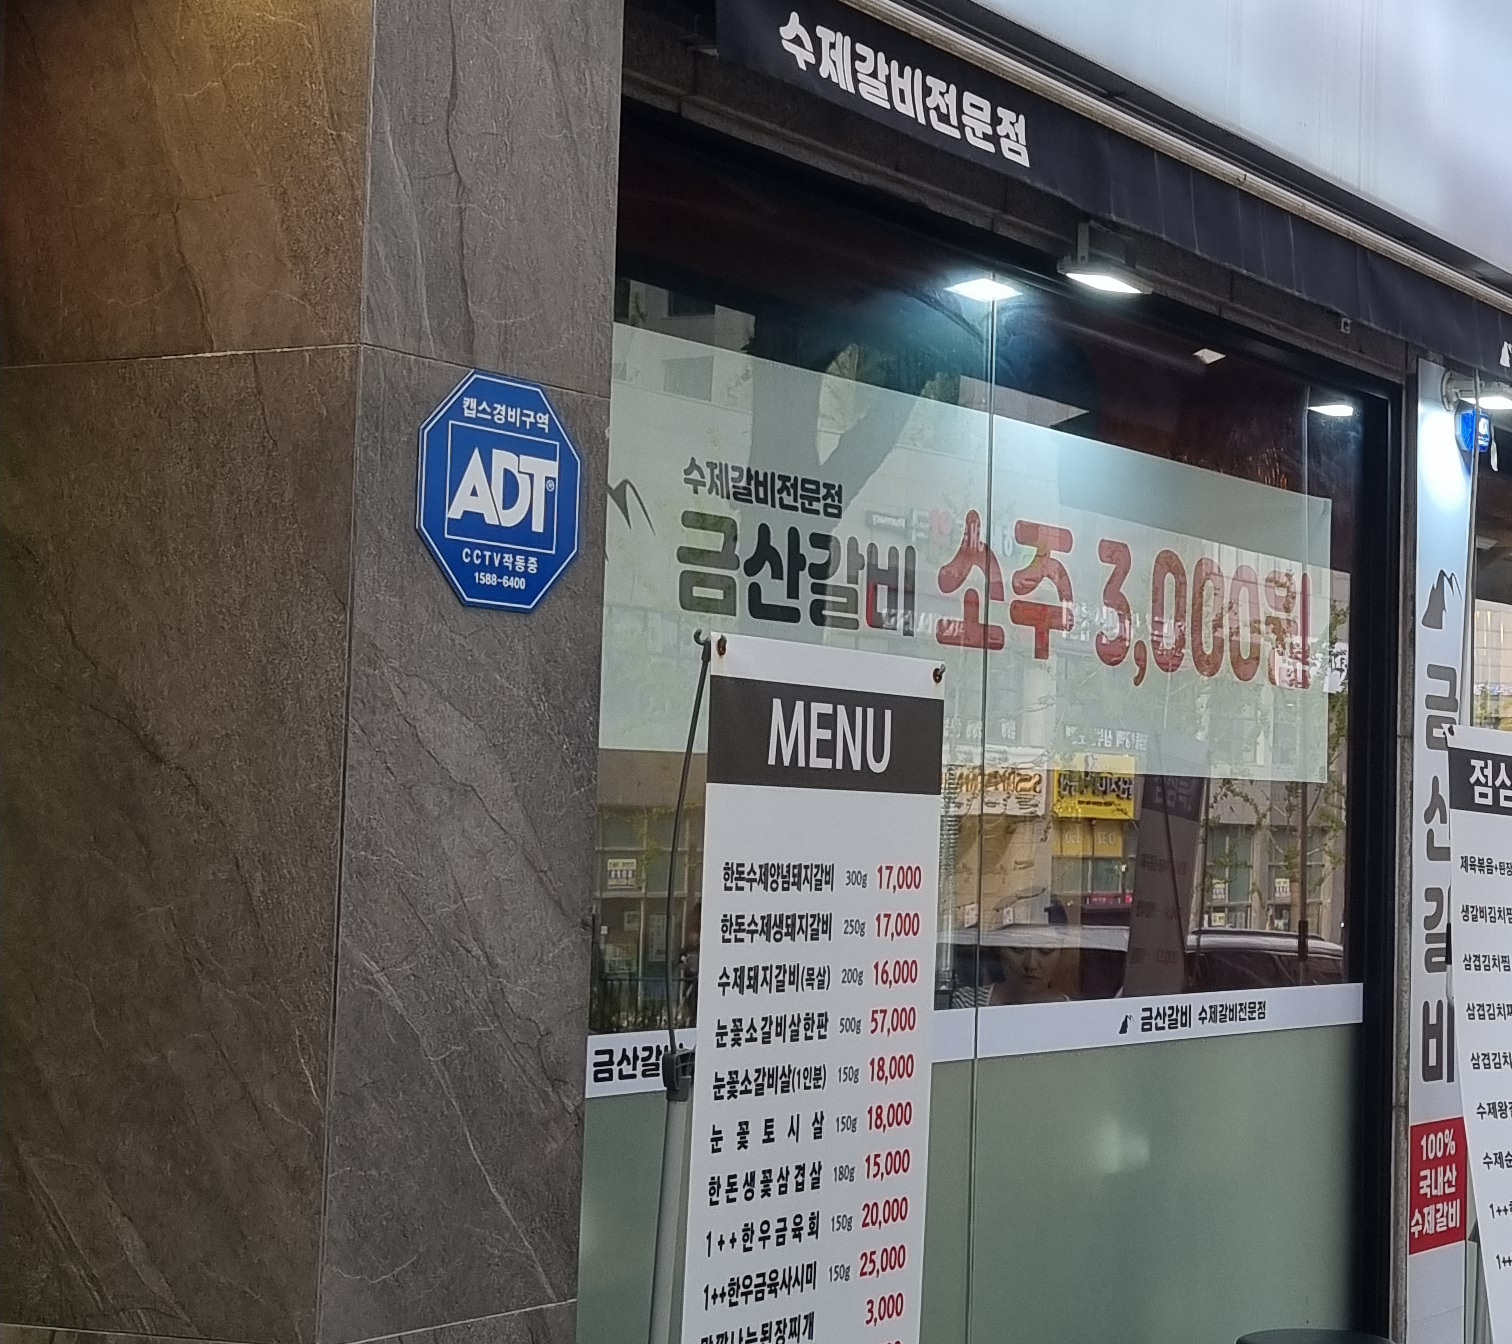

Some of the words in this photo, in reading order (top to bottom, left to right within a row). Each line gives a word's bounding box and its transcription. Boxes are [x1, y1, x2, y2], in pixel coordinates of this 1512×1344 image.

[778, 10, 1031, 168] 수제갈비전문점
[462, 396, 550, 434] 캡스경비구역
[447, 446, 559, 534] ADT
[683, 456, 843, 521] 수제갈비전문점
[462, 547, 539, 575] CCTV작동중
[676, 509, 917, 638] 금산갈비
[473, 571, 527, 591] 1588-6400
[935, 508, 1076, 661] 소주
[1095, 536, 1313, 691] 3,000원
[767, 696, 893, 774] MENU
[722, 861, 835, 893] 한돈수제양념돼지갈비
[845, 869, 868, 889] 300g
[876, 865, 922, 894] 17,000
[720, 912, 833, 944] 한돈수제생돼지갈비
[843, 918, 866, 938] 250g
[875, 912, 920, 941] 17,000
[717, 963, 832, 997] 수제돼지갈비(목살)
[841, 967, 864, 986] 200g
[873, 959, 918, 988] 16,000
[1462, 954, 1511, 973] 삼겹김치찜
[715, 1010, 829, 1048] 눈꽃소갈비살한판
[838, 1016, 862, 1035] 500g
[870, 1006, 916, 1036] 57,000
[1140, 1003, 1192, 1033] 금산갈비
[1197, 1000, 1267, 1026] 수제갈비전문점
[592, 1042, 668, 1084] 금산갈
[712, 1062, 828, 1101] 눈꽃소갈비살(1인분)
[837, 1065, 860, 1085] 150g
[868, 1054, 915, 1085] 18,000
[835, 1114, 858, 1134] 150g
[867, 1101, 912, 1132] 18,000
[1420, 1128, 1457, 1162] 100%
[708, 1160, 823, 1207] 한돈생꽃삼겹살
[833, 1164, 856, 1184] 180g
[864, 1148, 911, 1181] 15,000
[1418, 1163, 1458, 1199] 국내산
[830, 1214, 854, 1234] 150g
[861, 1196, 909, 1229] 20,000
[1409, 1198, 1462, 1238] 수제갈비
[703, 1261, 818, 1311] 1++한우금육사시미
[828, 1263, 851, 1283] 150g
[859, 1244, 907, 1278] 25,000
[865, 1292, 904, 1326] 3,000
